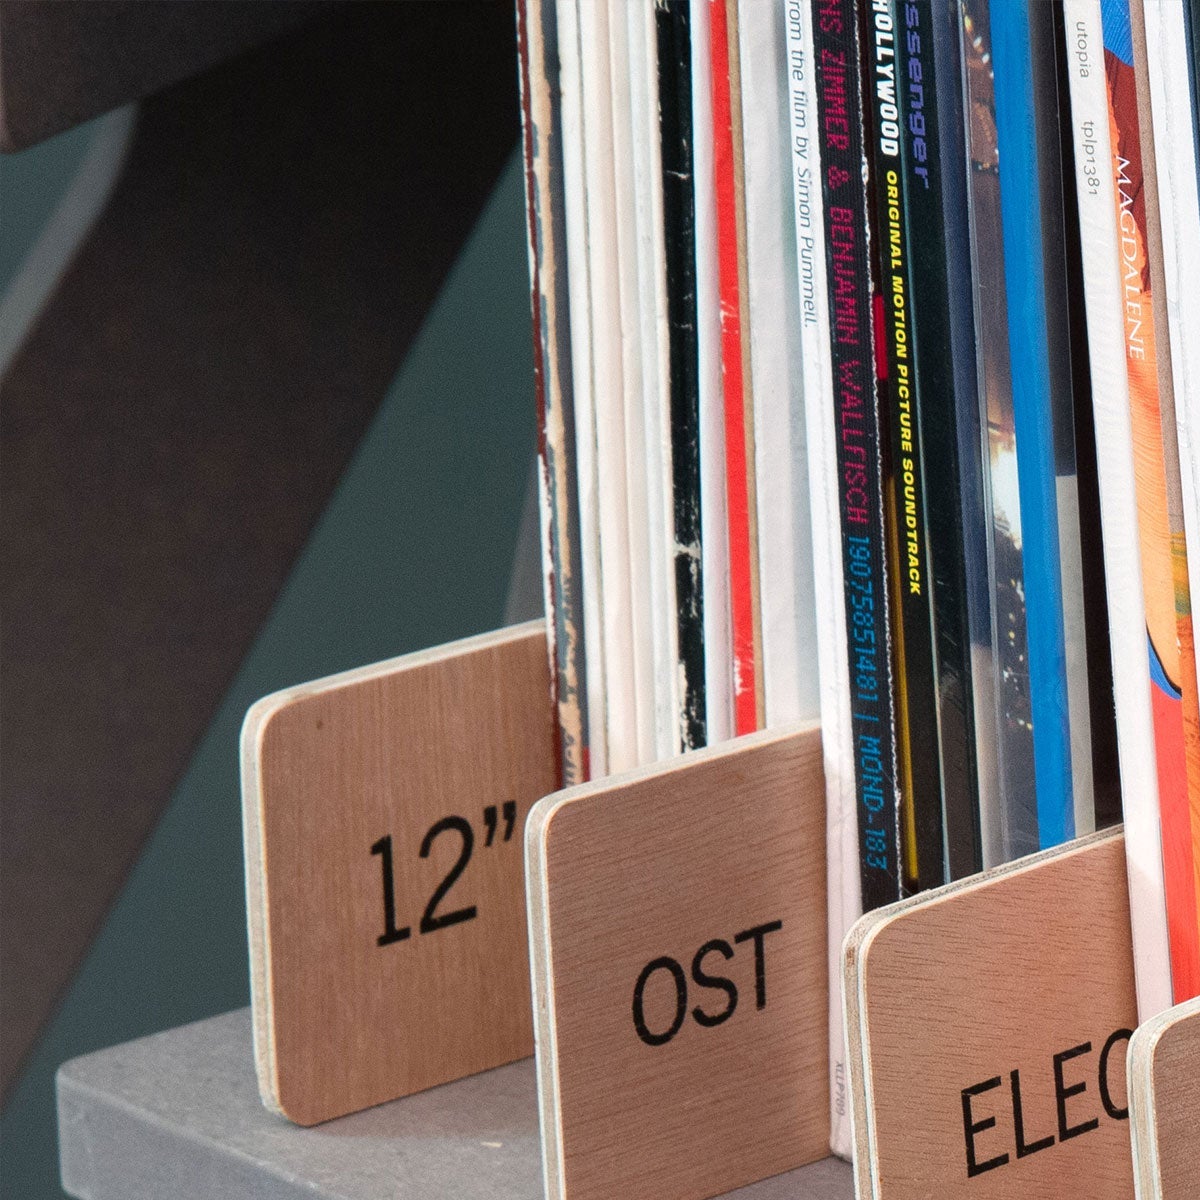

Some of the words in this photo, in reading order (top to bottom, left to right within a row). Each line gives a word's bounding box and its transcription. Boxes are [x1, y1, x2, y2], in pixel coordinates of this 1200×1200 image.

[791, 49, 805, 82] the
[872, 0, 899, 156] HOLLYWOOD
[1075, 21, 1090, 78] utopia
[793, 90, 808, 129] film
[821, 48, 850, 150] ZIMMER
[795, 136, 809, 160] by
[828, 165, 849, 190] &
[1081, 120, 1101, 196] tplp1381
[797, 167, 813, 229] Simon
[886, 170, 903, 269] ORIGINAL
[800, 236, 817, 329] Pummell.
[830, 206, 859, 346] BENJAMIN
[1114, 155, 1145, 360] MAGDALENE
[892, 276, 908, 358] MOTION
[838, 358, 869, 525] WALLFISCH
[896, 365, 913, 452] PICTURE
[901, 458, 921, 596] SOUNDTRACK
[860, 738, 888, 870] MOND-183
[631, 919, 783, 1046] OST
